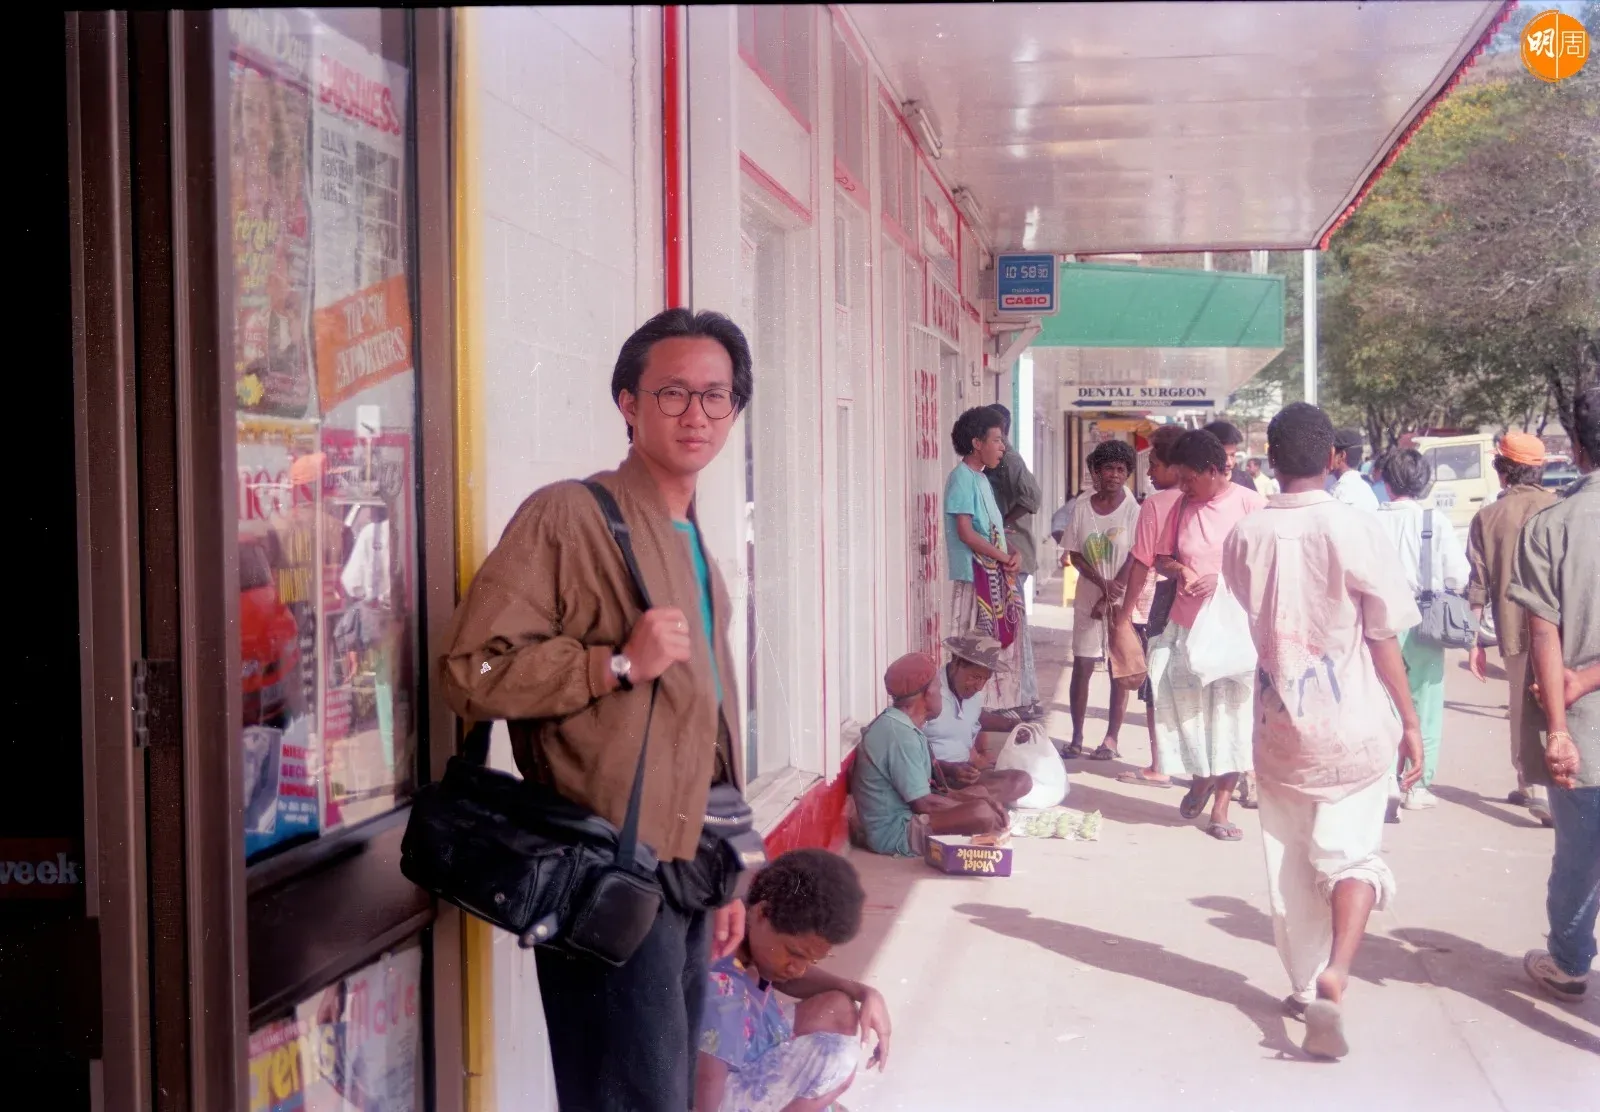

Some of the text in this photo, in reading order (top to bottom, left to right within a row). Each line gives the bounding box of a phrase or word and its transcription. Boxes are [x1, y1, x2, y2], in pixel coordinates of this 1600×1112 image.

[1005, 296, 1047, 305] CASIO
[1078, 387, 1207, 397] DENTAL SURGEON
[957, 848, 1003, 863] Crumble
[964, 860, 995, 873] Violet
